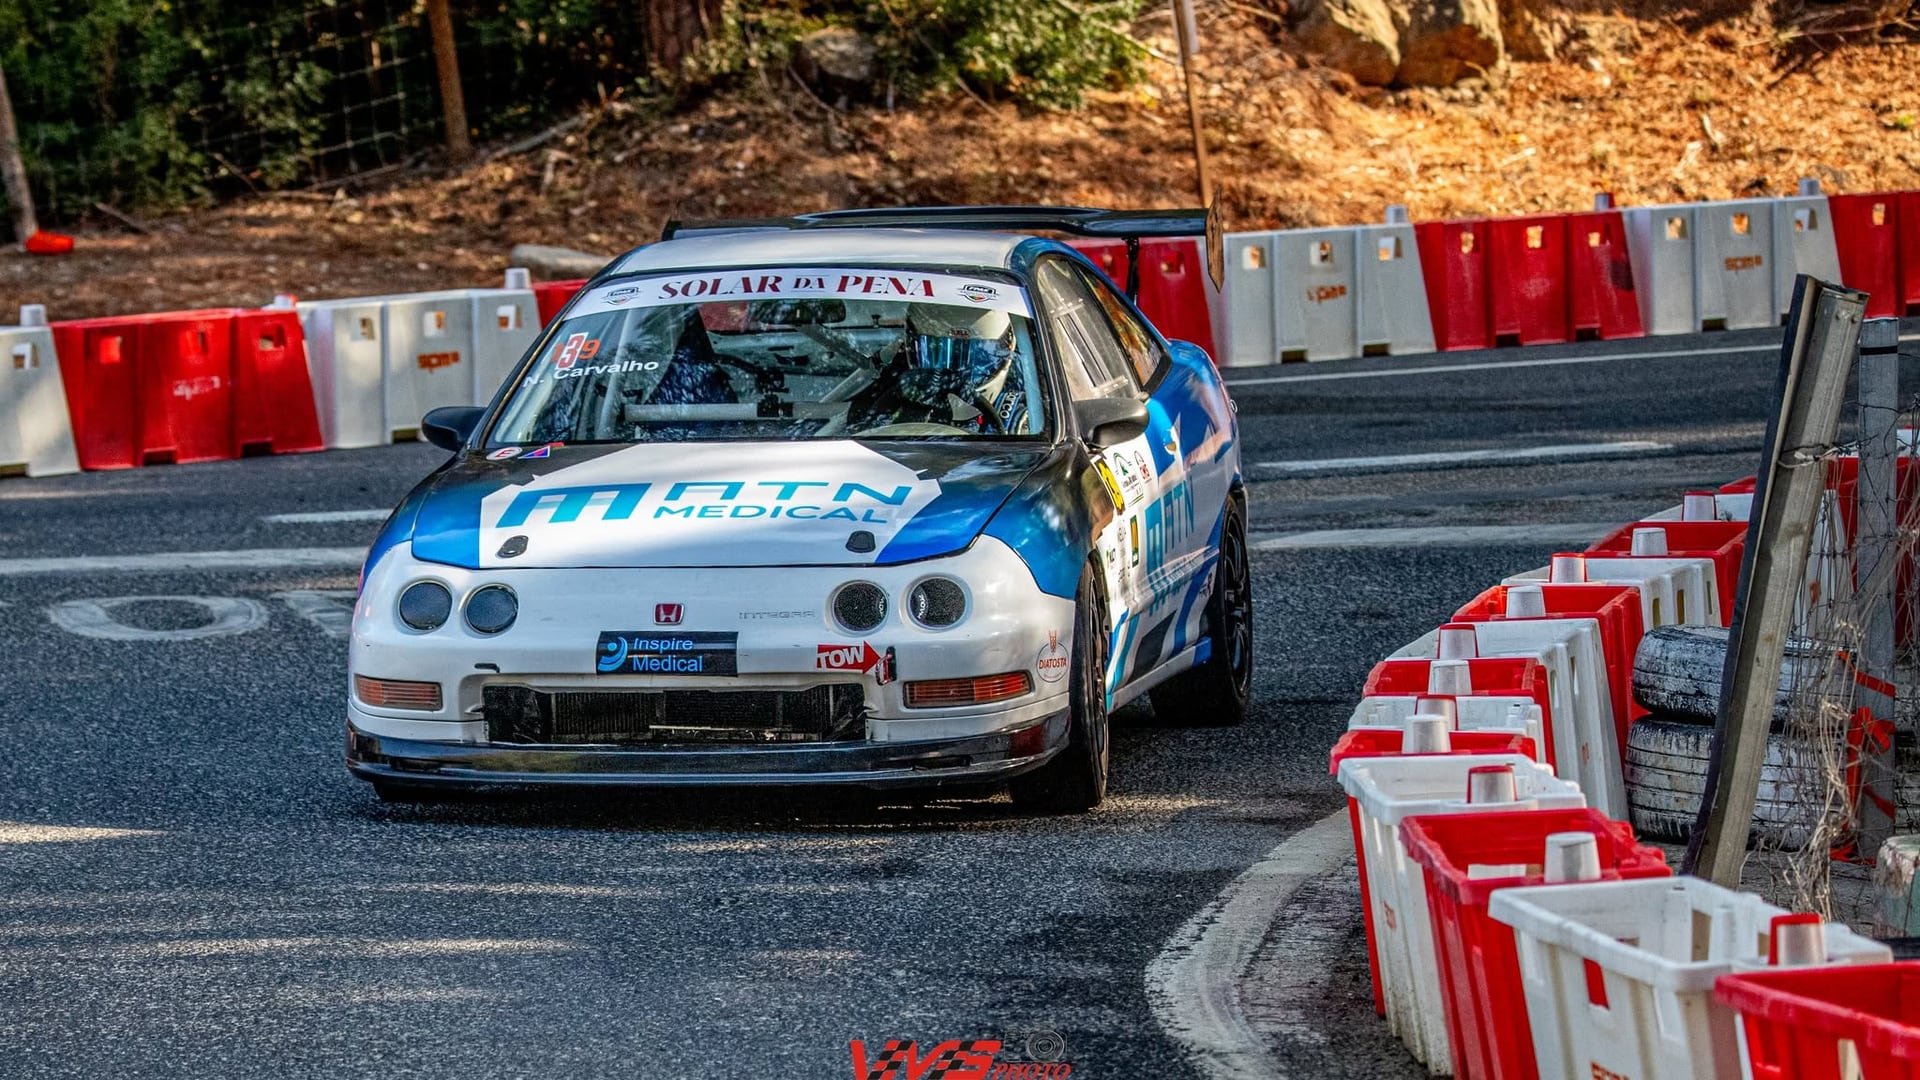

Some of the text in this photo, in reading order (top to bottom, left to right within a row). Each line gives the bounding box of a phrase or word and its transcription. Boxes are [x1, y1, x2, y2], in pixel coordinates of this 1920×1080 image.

[658, 275, 935, 300] SOLAR DA PENA
[551, 332, 601, 370] 139
[523, 361, 659, 388] N. Carvalho
[653, 505, 888, 523] MEDICAL
[633, 638, 694, 653] Inspire
[632, 655, 703, 672] Medical
[817, 647, 864, 668] TOW
[1039, 657, 1067, 669] DIATOSTA
